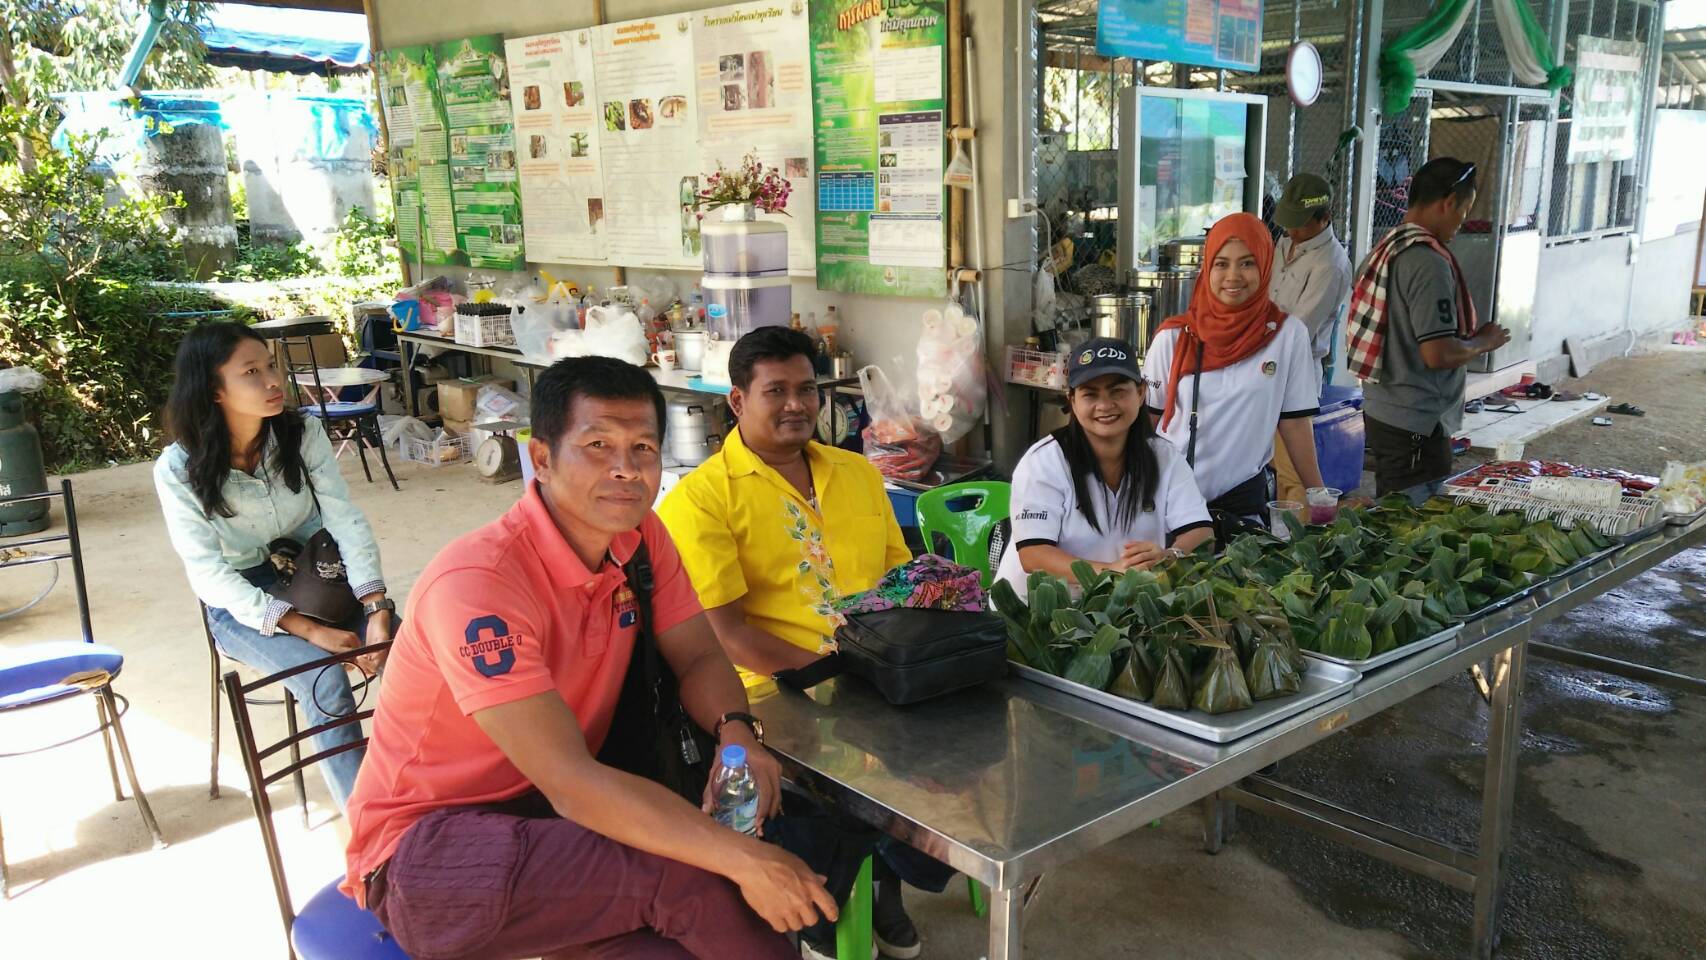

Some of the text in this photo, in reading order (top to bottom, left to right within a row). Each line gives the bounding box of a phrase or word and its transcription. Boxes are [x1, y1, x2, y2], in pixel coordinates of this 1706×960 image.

[1097, 347, 1127, 360] CDD
[459, 645, 471, 657] CC
[470, 636, 515, 655] DOUBLE
